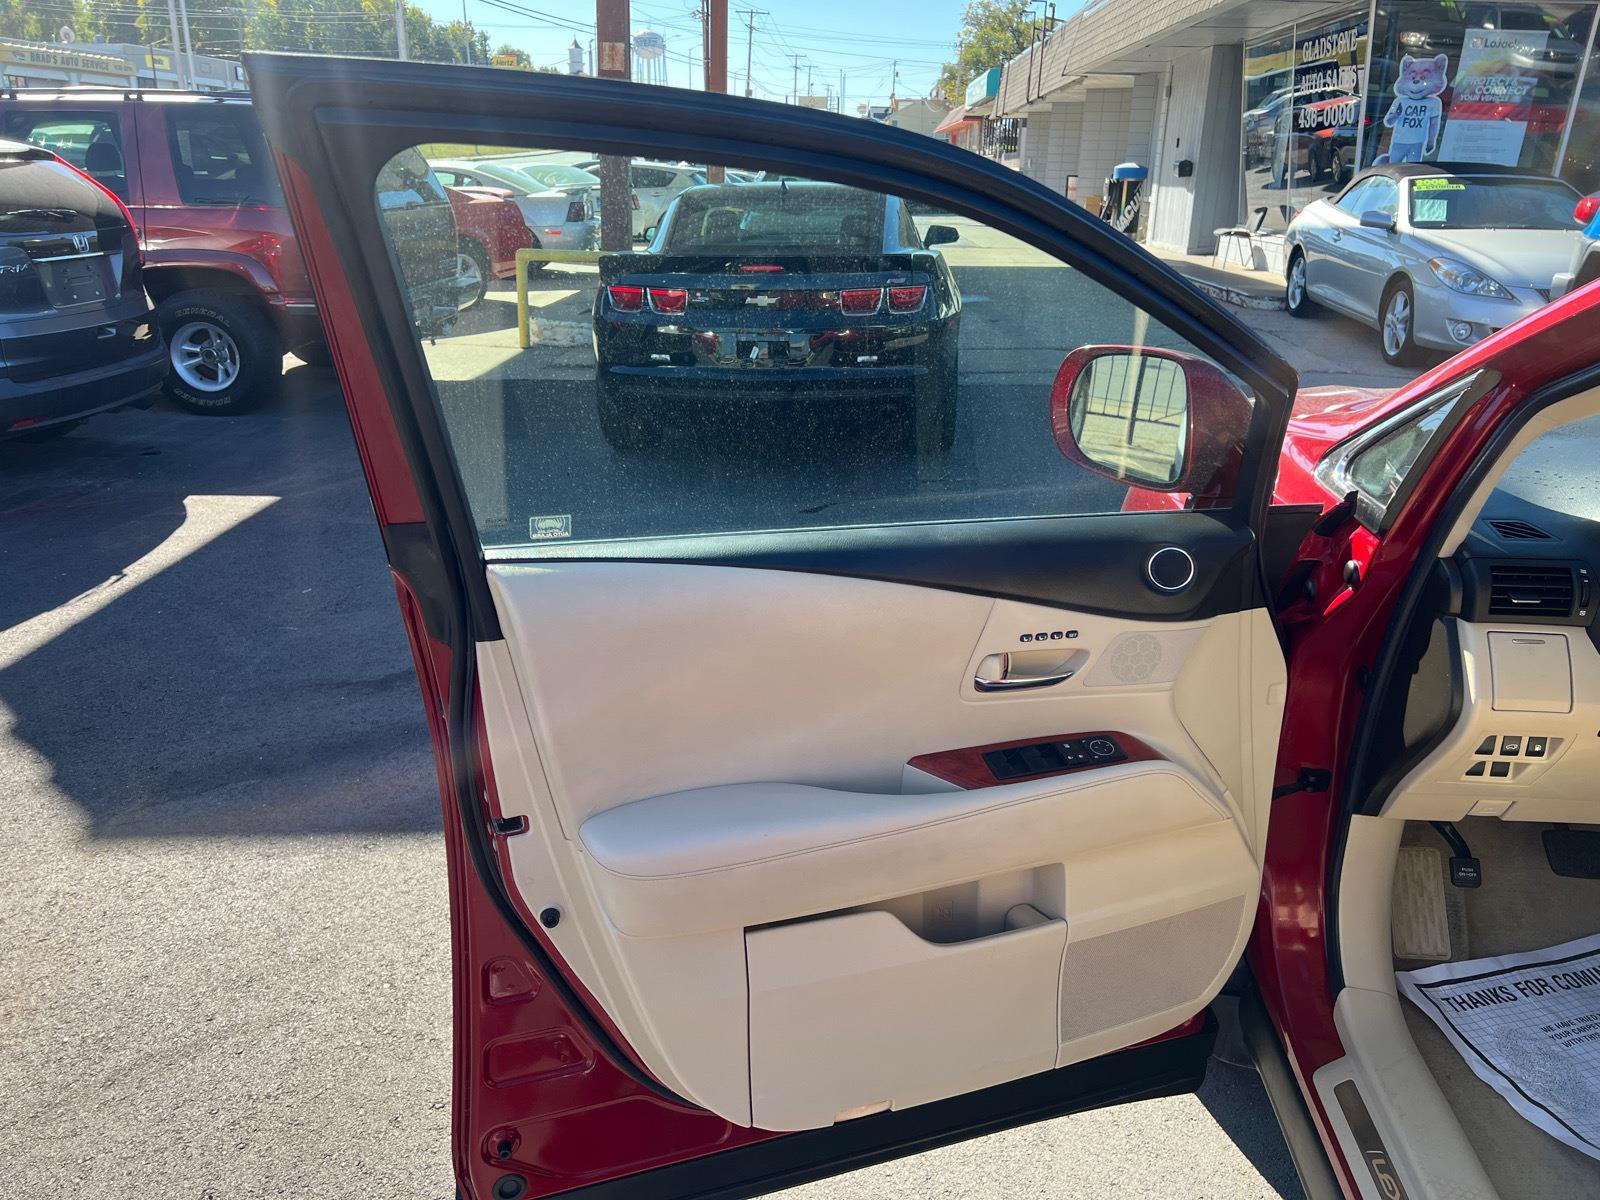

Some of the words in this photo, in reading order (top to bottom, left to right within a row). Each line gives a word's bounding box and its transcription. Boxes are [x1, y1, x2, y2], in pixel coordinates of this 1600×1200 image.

[1303, 30, 1358, 63] GLADSTONE
[30, 51, 58, 65] BRAD'S
[60, 57, 79, 67] AUTO
[82, 59, 109, 71] SERVICE
[1300, 72, 1324, 96] AUTO
[1475, 86, 1528, 96] CONNECT
[1299, 105, 1355, 129] 436-0000
[1404, 105, 1427, 117] CAR
[1402, 117, 1424, 129] FOX
[1441, 985, 1518, 1013] THANKS
[1513, 978, 1556, 998] FOR
[1541, 1024, 1557, 1033] WE
[1554, 1020, 1576, 1029] HAVE
[1573, 1014, 1598, 1024] TRIED
[1549, 1030, 1573, 1041] YOUR
[1562, 1037, 1584, 1048] WITH
